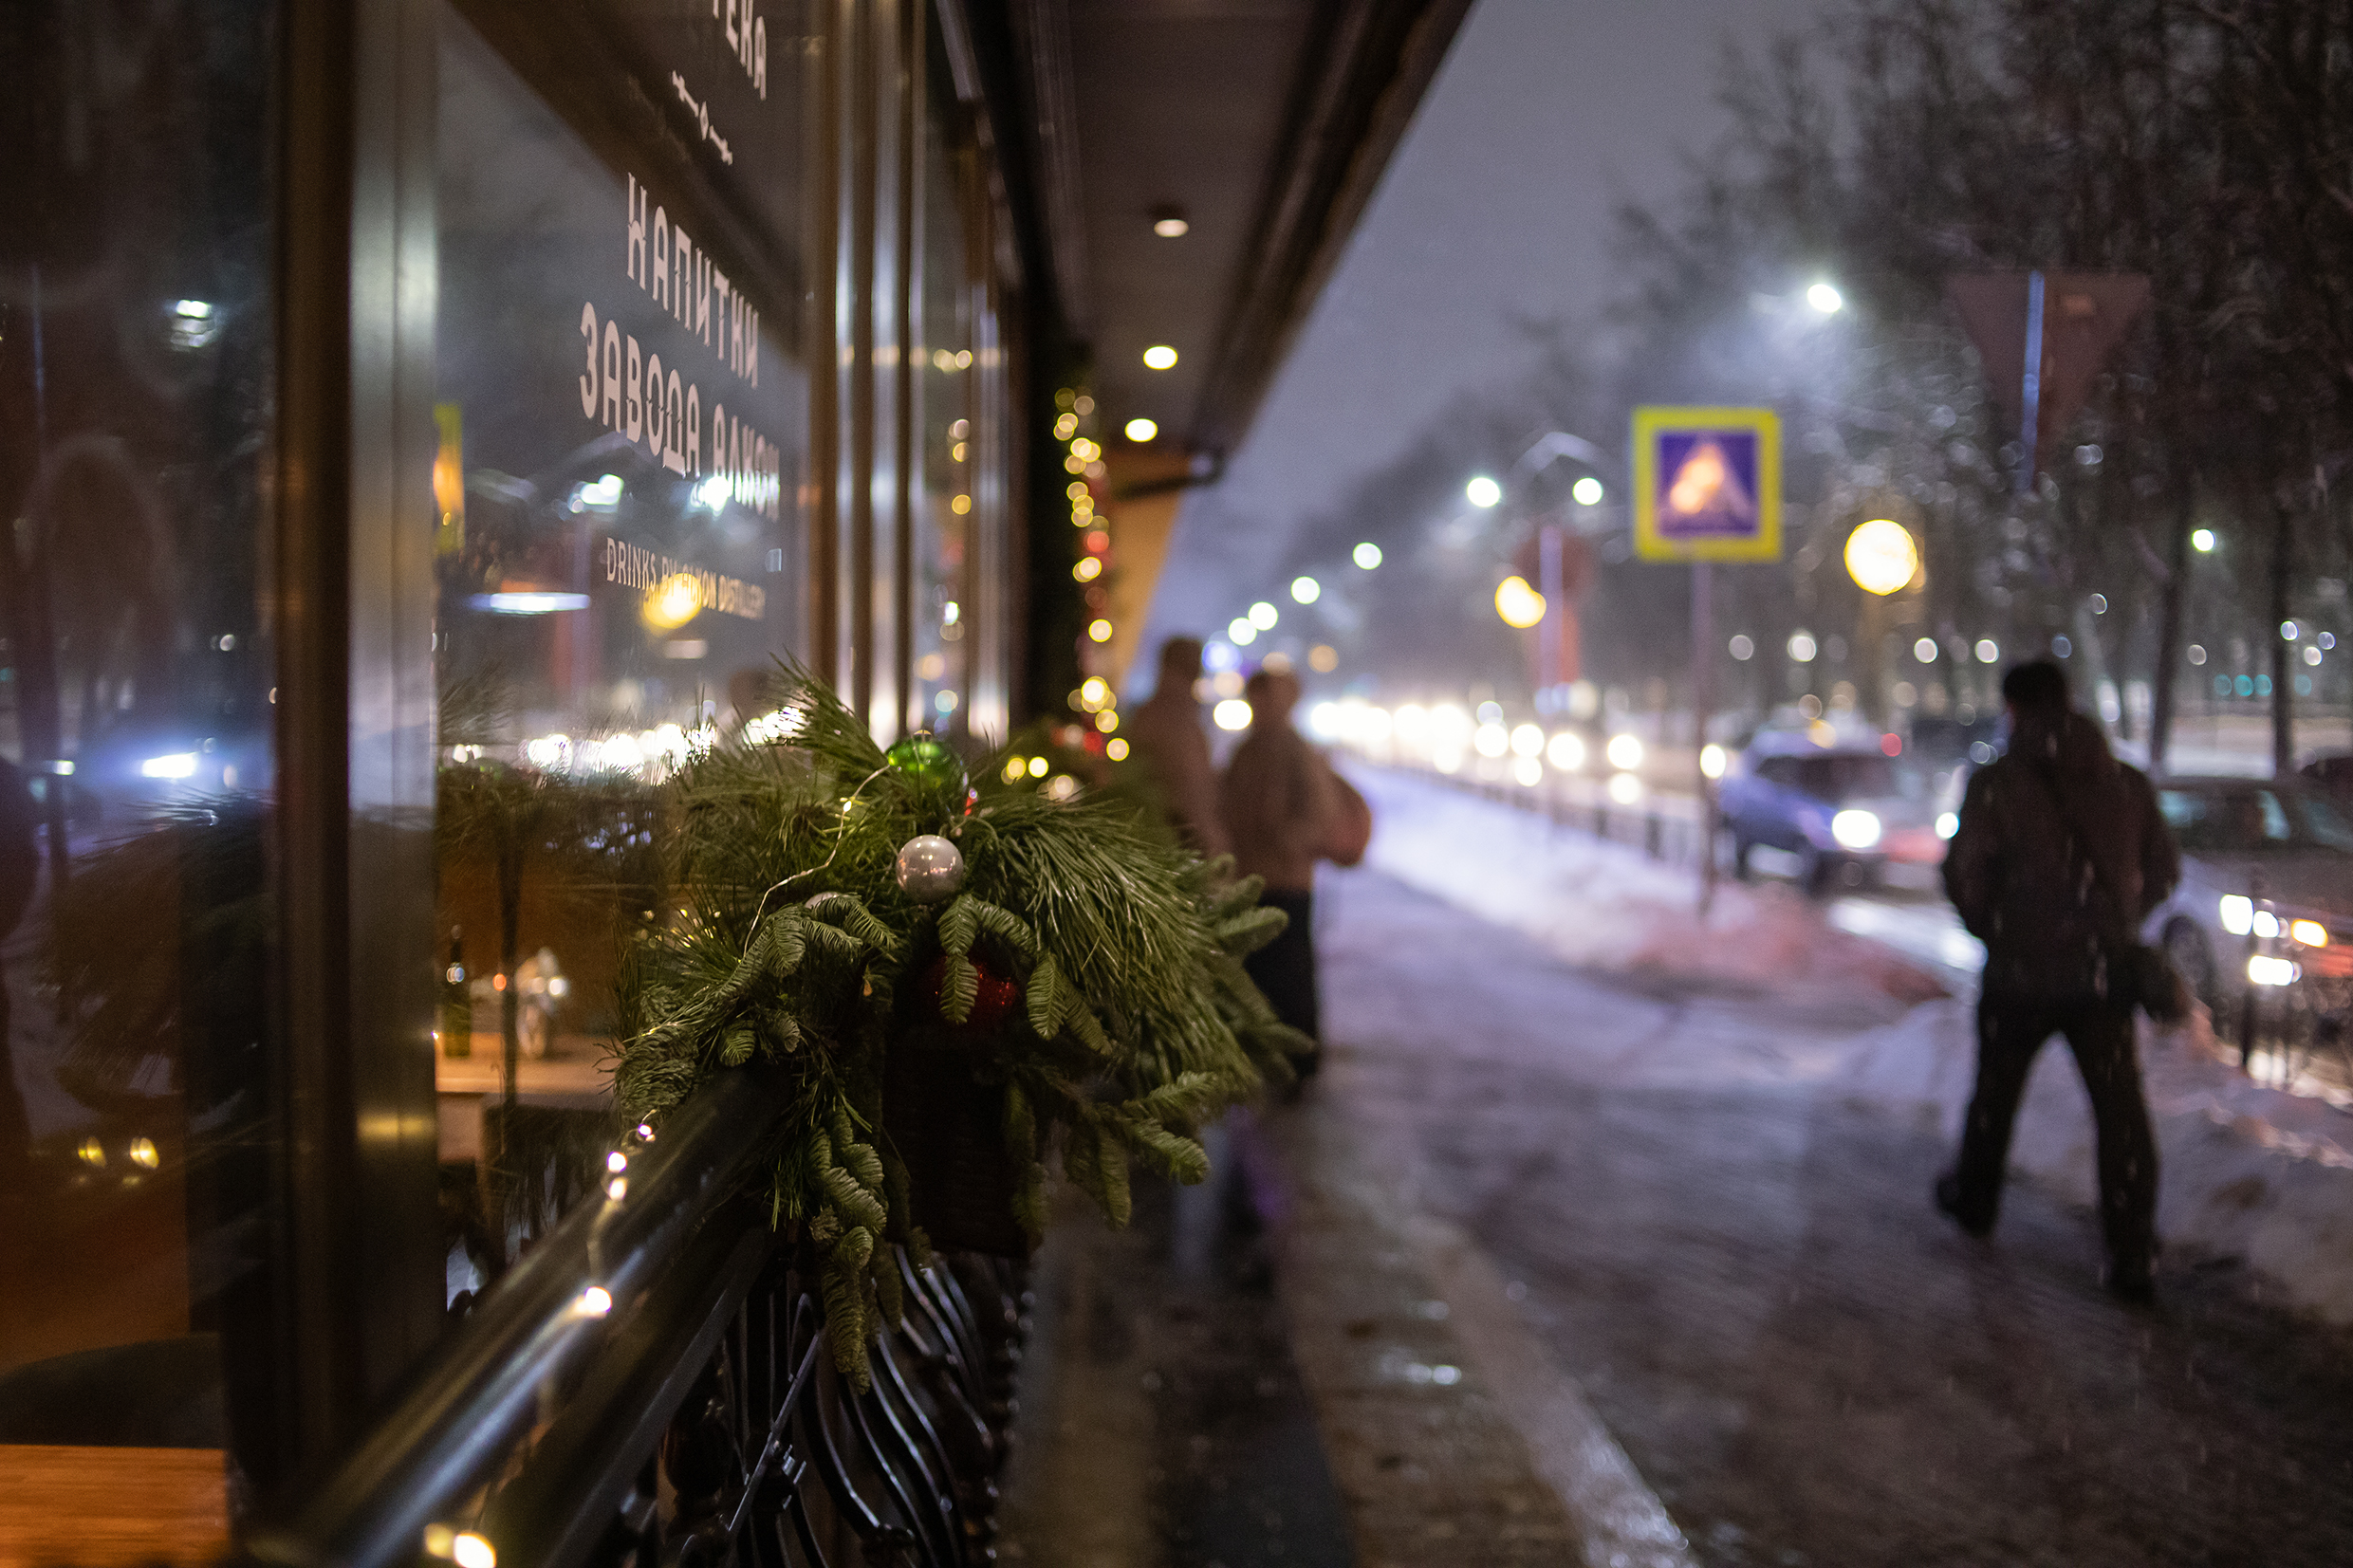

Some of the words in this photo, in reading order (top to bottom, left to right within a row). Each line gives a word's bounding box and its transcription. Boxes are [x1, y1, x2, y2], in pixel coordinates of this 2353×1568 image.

[713, 0, 767, 101] ЕКА
[627, 172, 759, 389] НАПИТКИ
[580, 302, 701, 479] ЗАВОДА
[607, 537, 657, 592] DRINKS
